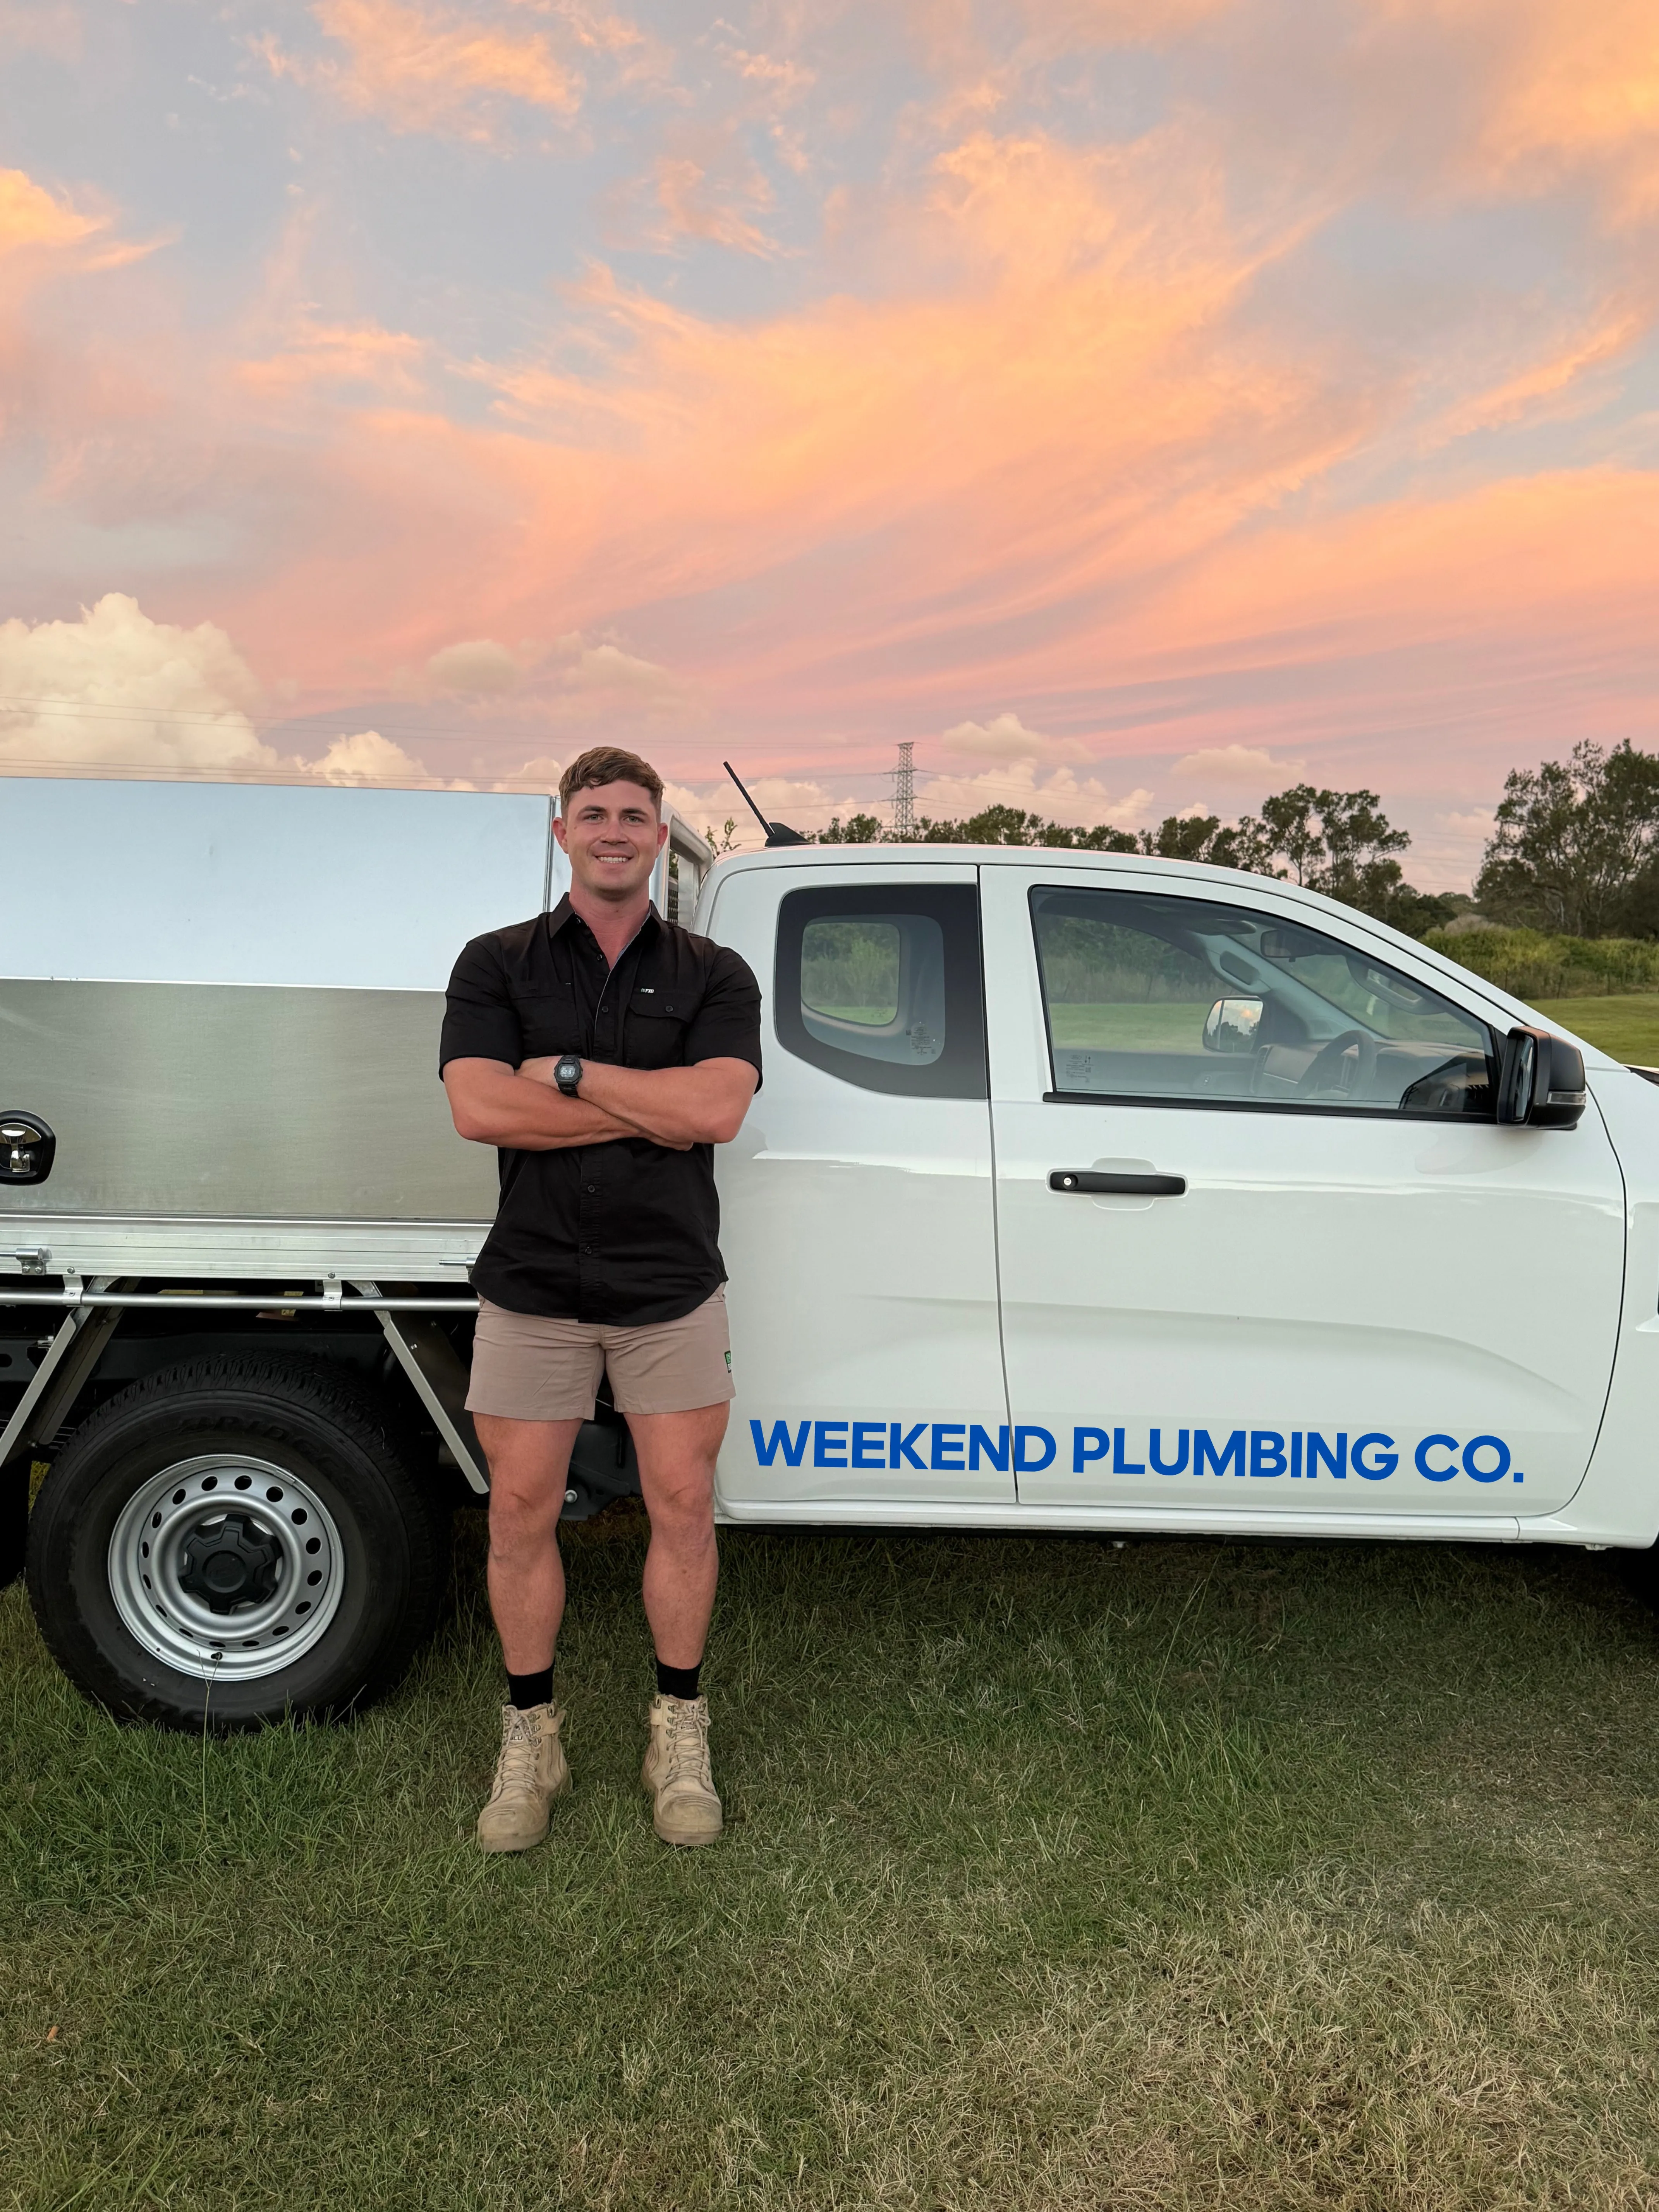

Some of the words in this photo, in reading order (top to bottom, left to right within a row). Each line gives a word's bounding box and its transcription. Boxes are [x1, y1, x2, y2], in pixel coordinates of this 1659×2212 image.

[749, 1419, 1057, 1472] WEEKEND
[1073, 1427, 1399, 1481] PLUMBING
[1414, 1434, 1524, 1483] CO.
